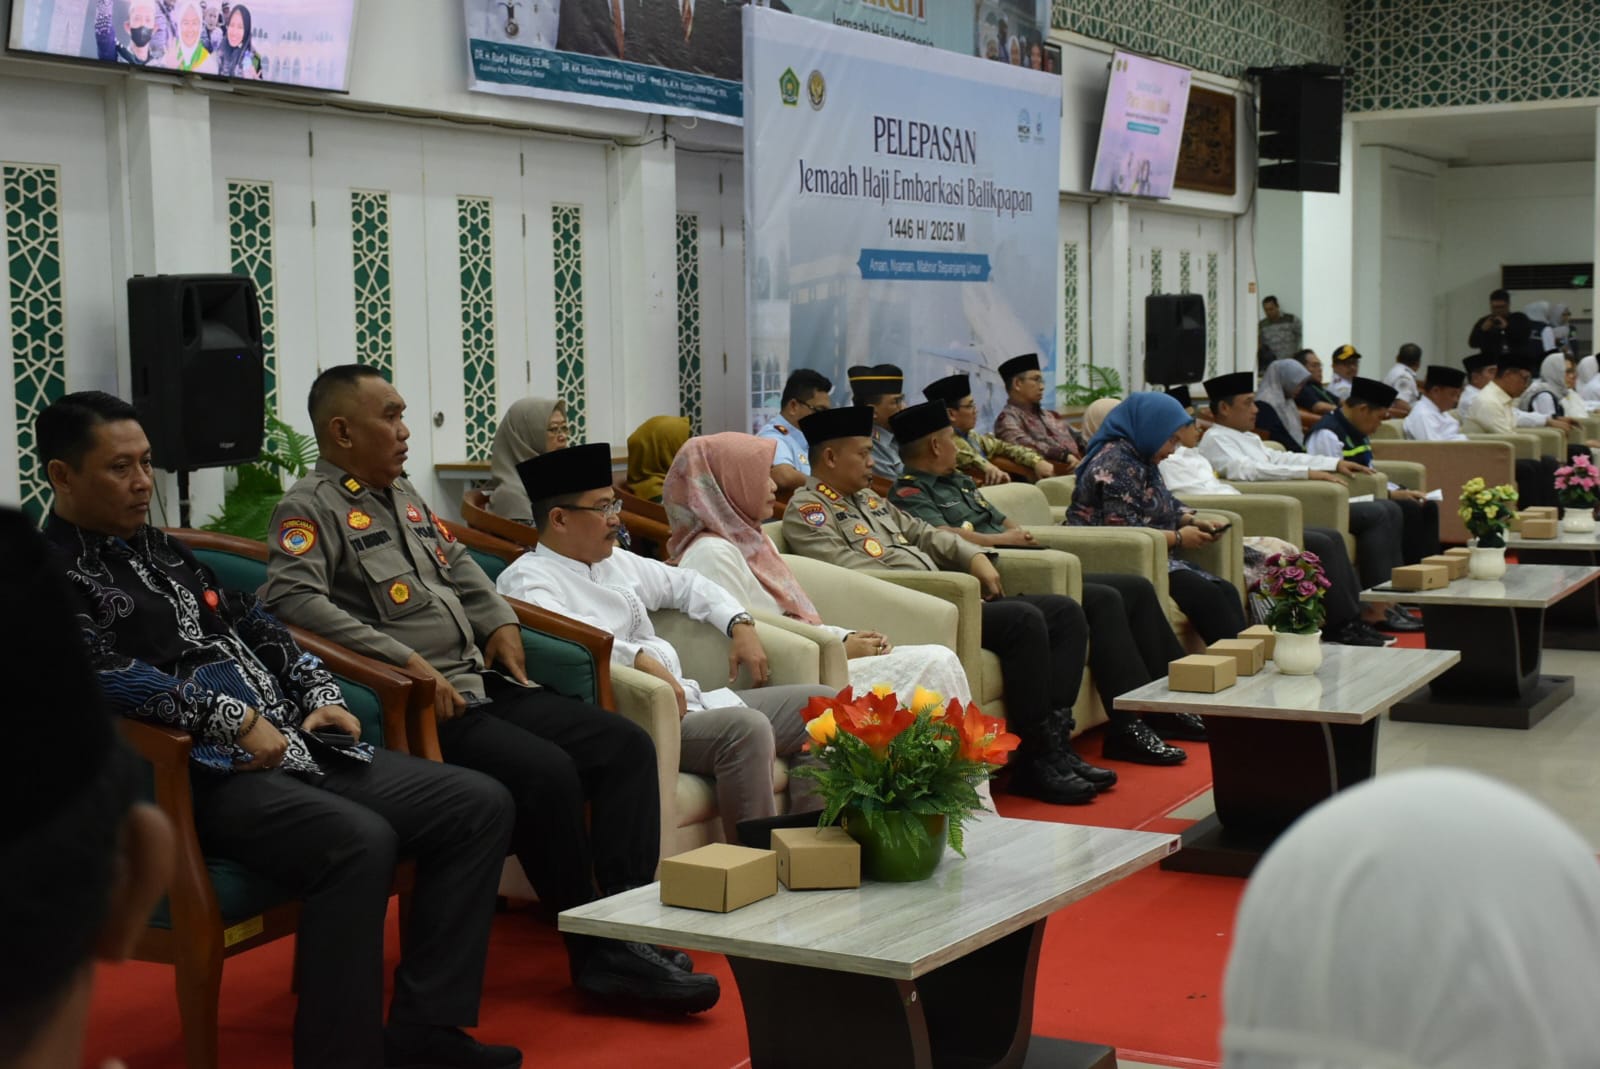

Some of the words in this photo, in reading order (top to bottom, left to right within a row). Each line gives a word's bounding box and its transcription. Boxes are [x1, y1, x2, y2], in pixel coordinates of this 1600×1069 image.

[873, 115, 977, 164] PELEPASAN
[799, 159, 858, 196] Jemaah
[862, 165, 890, 206] Haji
[893, 169, 964, 206] Embarkasi
[967, 177, 1033, 219] Balikpapan
[888, 217, 914, 240] 1446
[930, 220, 955, 242] 2025
[956, 222, 966, 242] M
